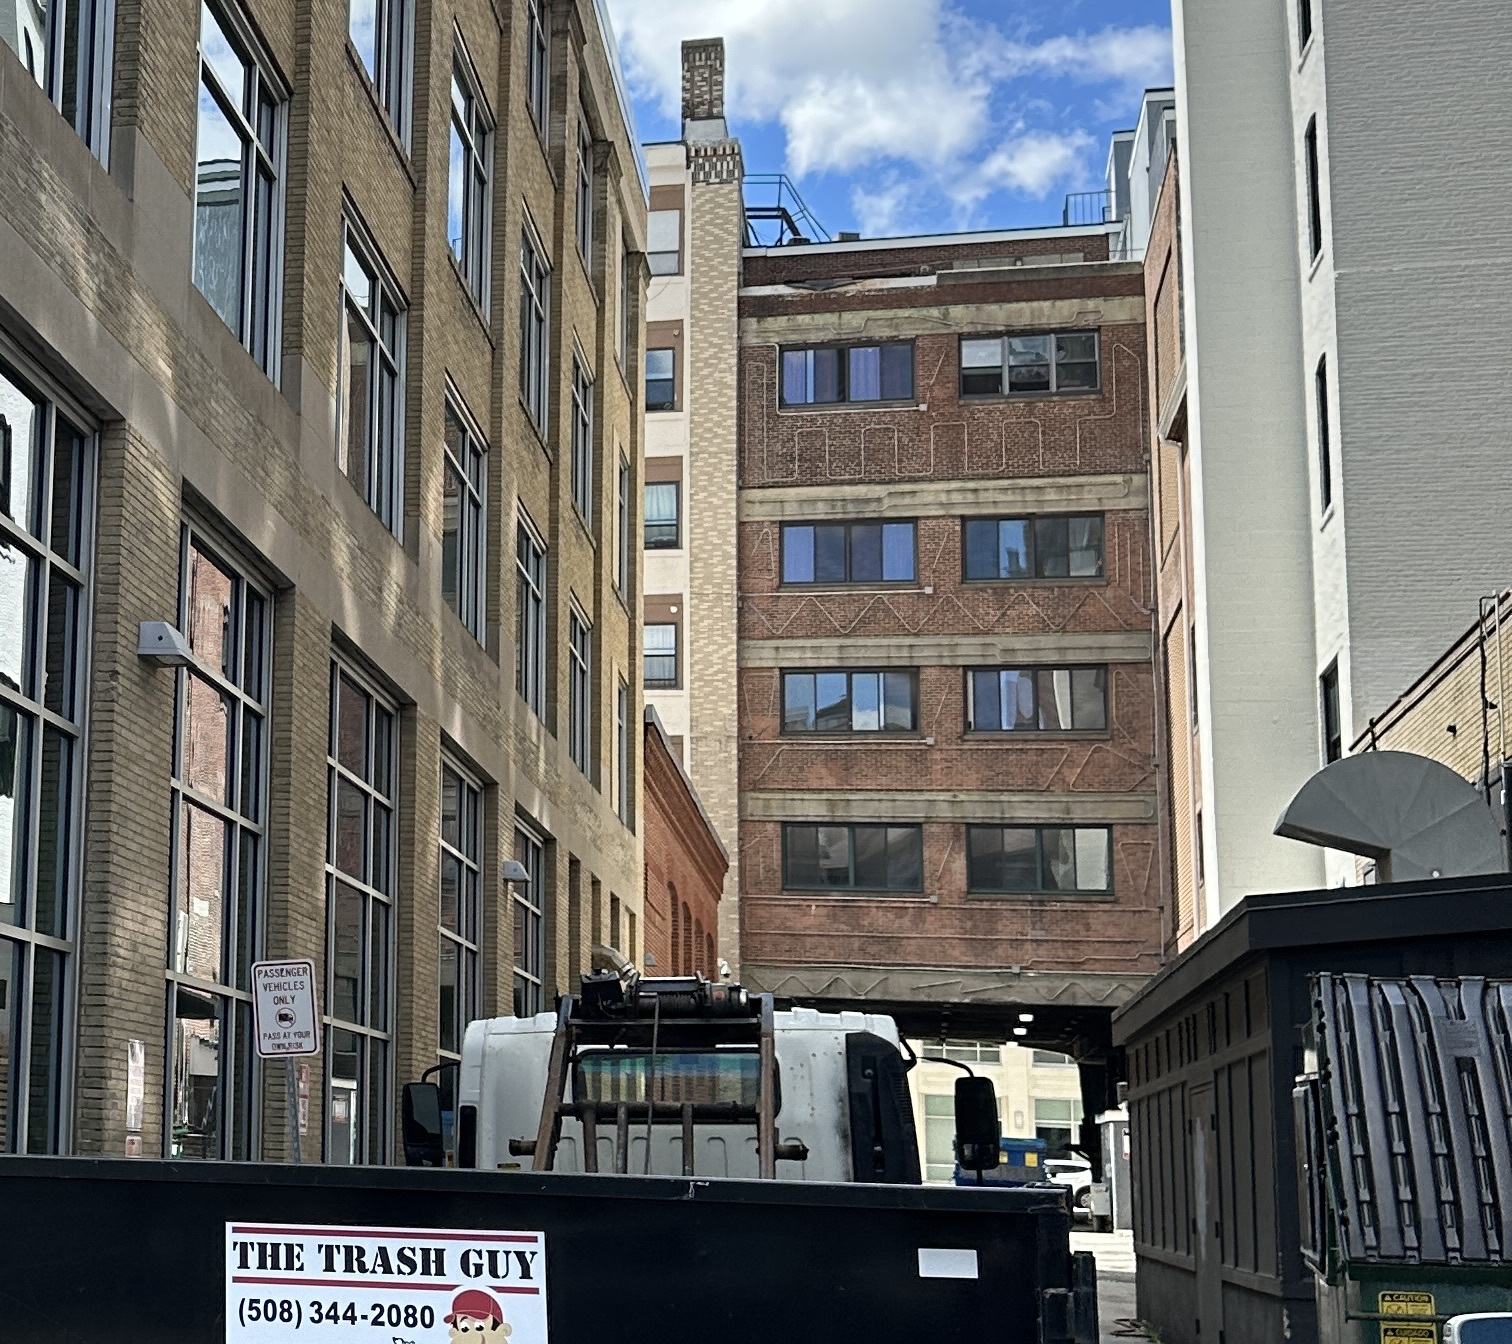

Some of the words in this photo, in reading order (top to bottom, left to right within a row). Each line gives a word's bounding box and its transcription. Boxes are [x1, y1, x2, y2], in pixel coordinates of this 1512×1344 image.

[257, 967, 308, 978] PASSENGER
[263, 981, 305, 992] VEHICLES
[273, 995, 296, 1005] ONLY
[263, 1032, 281, 1040] PASS
[282, 1031, 291, 1039] AT
[233, 1240, 305, 1272] THE
[317, 1243, 447, 1277] TRASH
[459, 1248, 538, 1280] GUY
[1393, 1294, 1429, 1302] CAUTION
[238, 1297, 303, 1329] (508)
[309, 1300, 435, 1329] 344-2080
